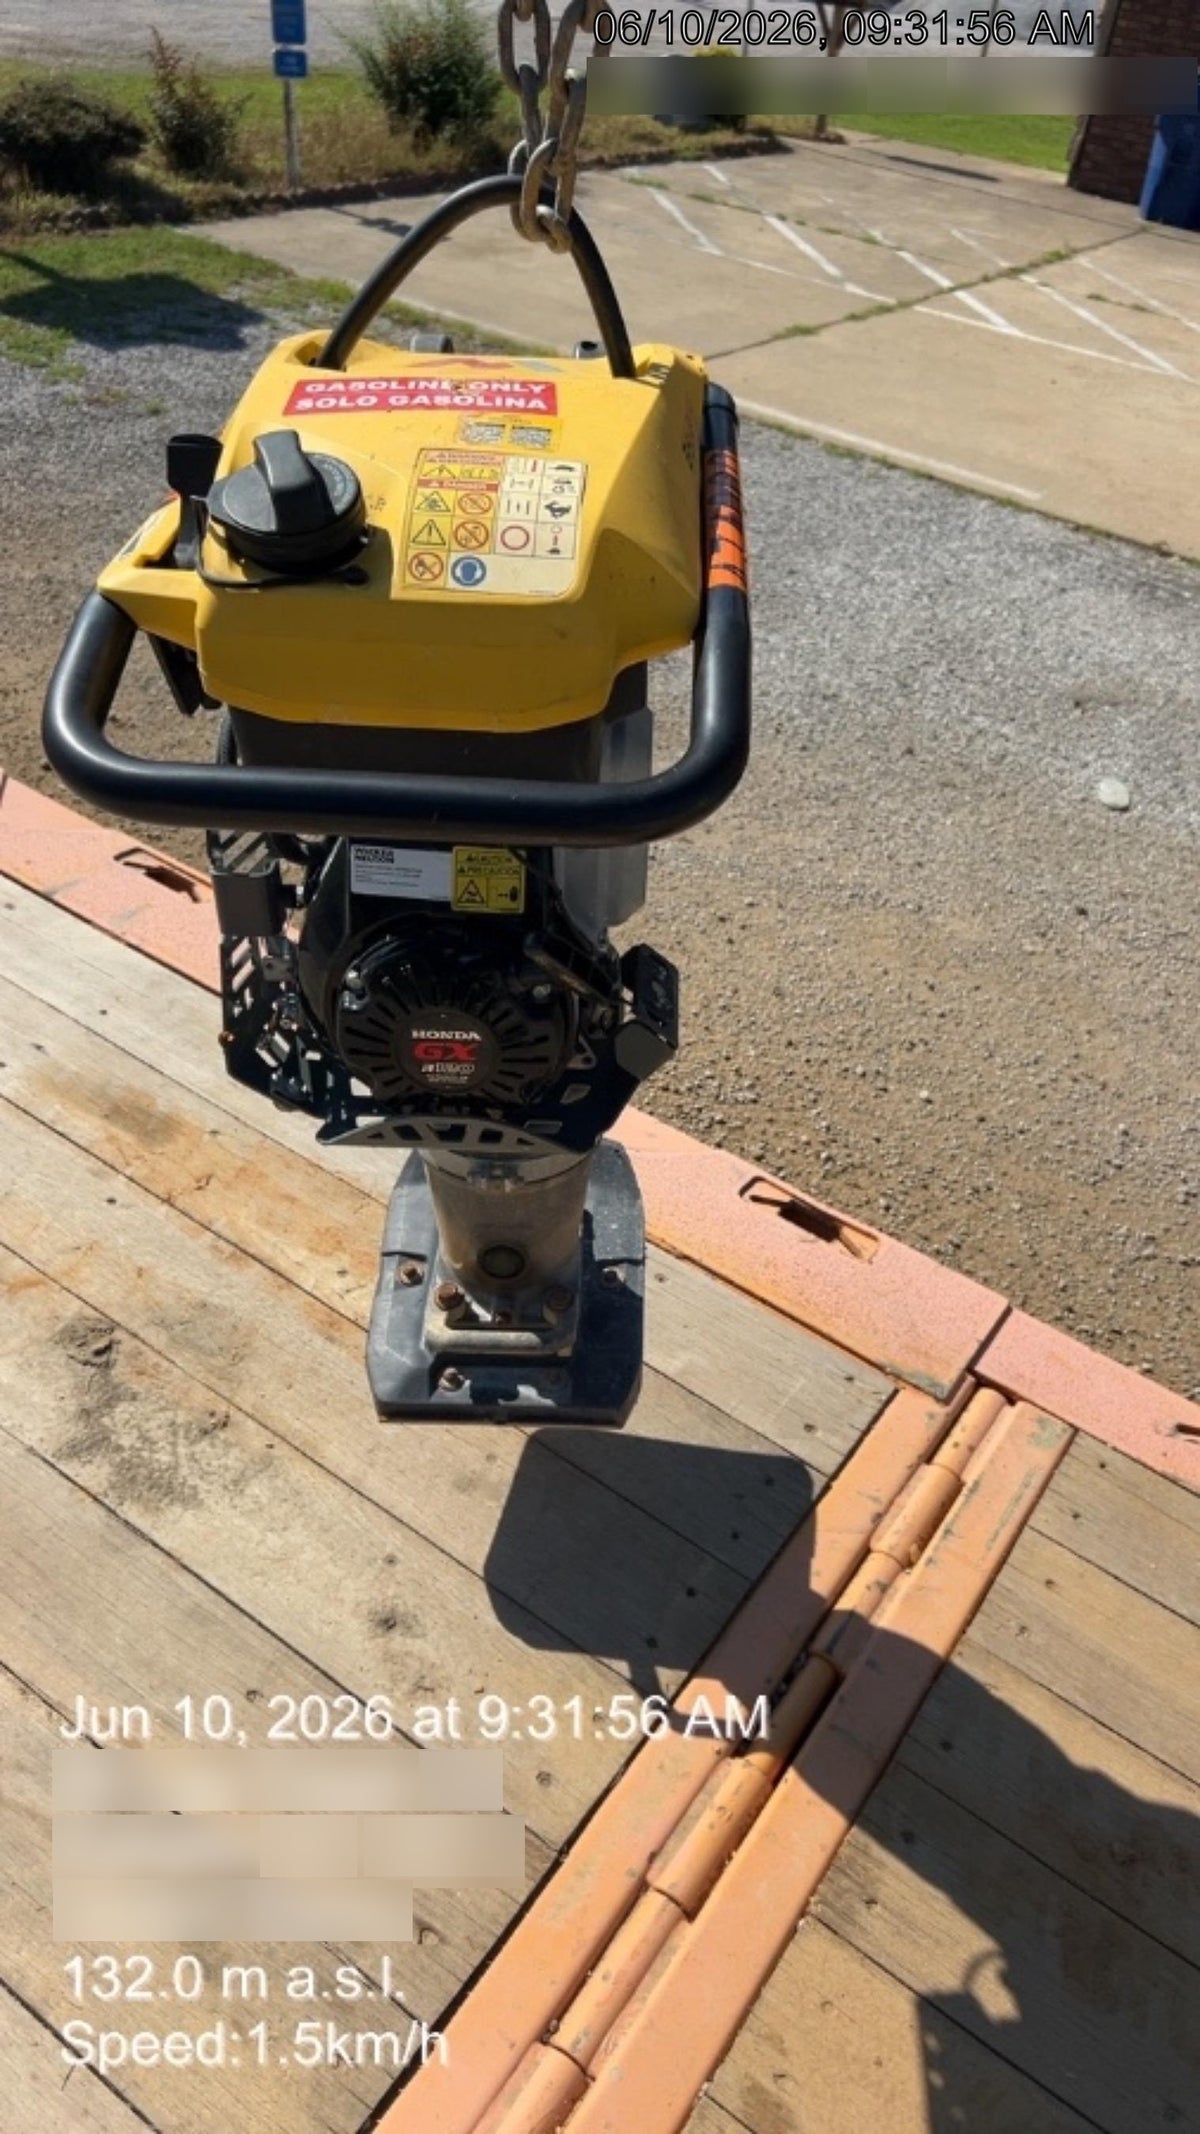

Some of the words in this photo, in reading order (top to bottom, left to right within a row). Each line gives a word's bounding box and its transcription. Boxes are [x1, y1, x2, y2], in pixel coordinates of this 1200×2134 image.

[468, 380, 547, 394] ONLY
[294, 395, 378, 411] SOLO
[387, 393, 547, 410] GASOLINA
[412, 1030, 481, 1040] HONDA
[414, 1042, 478, 1060] GX
